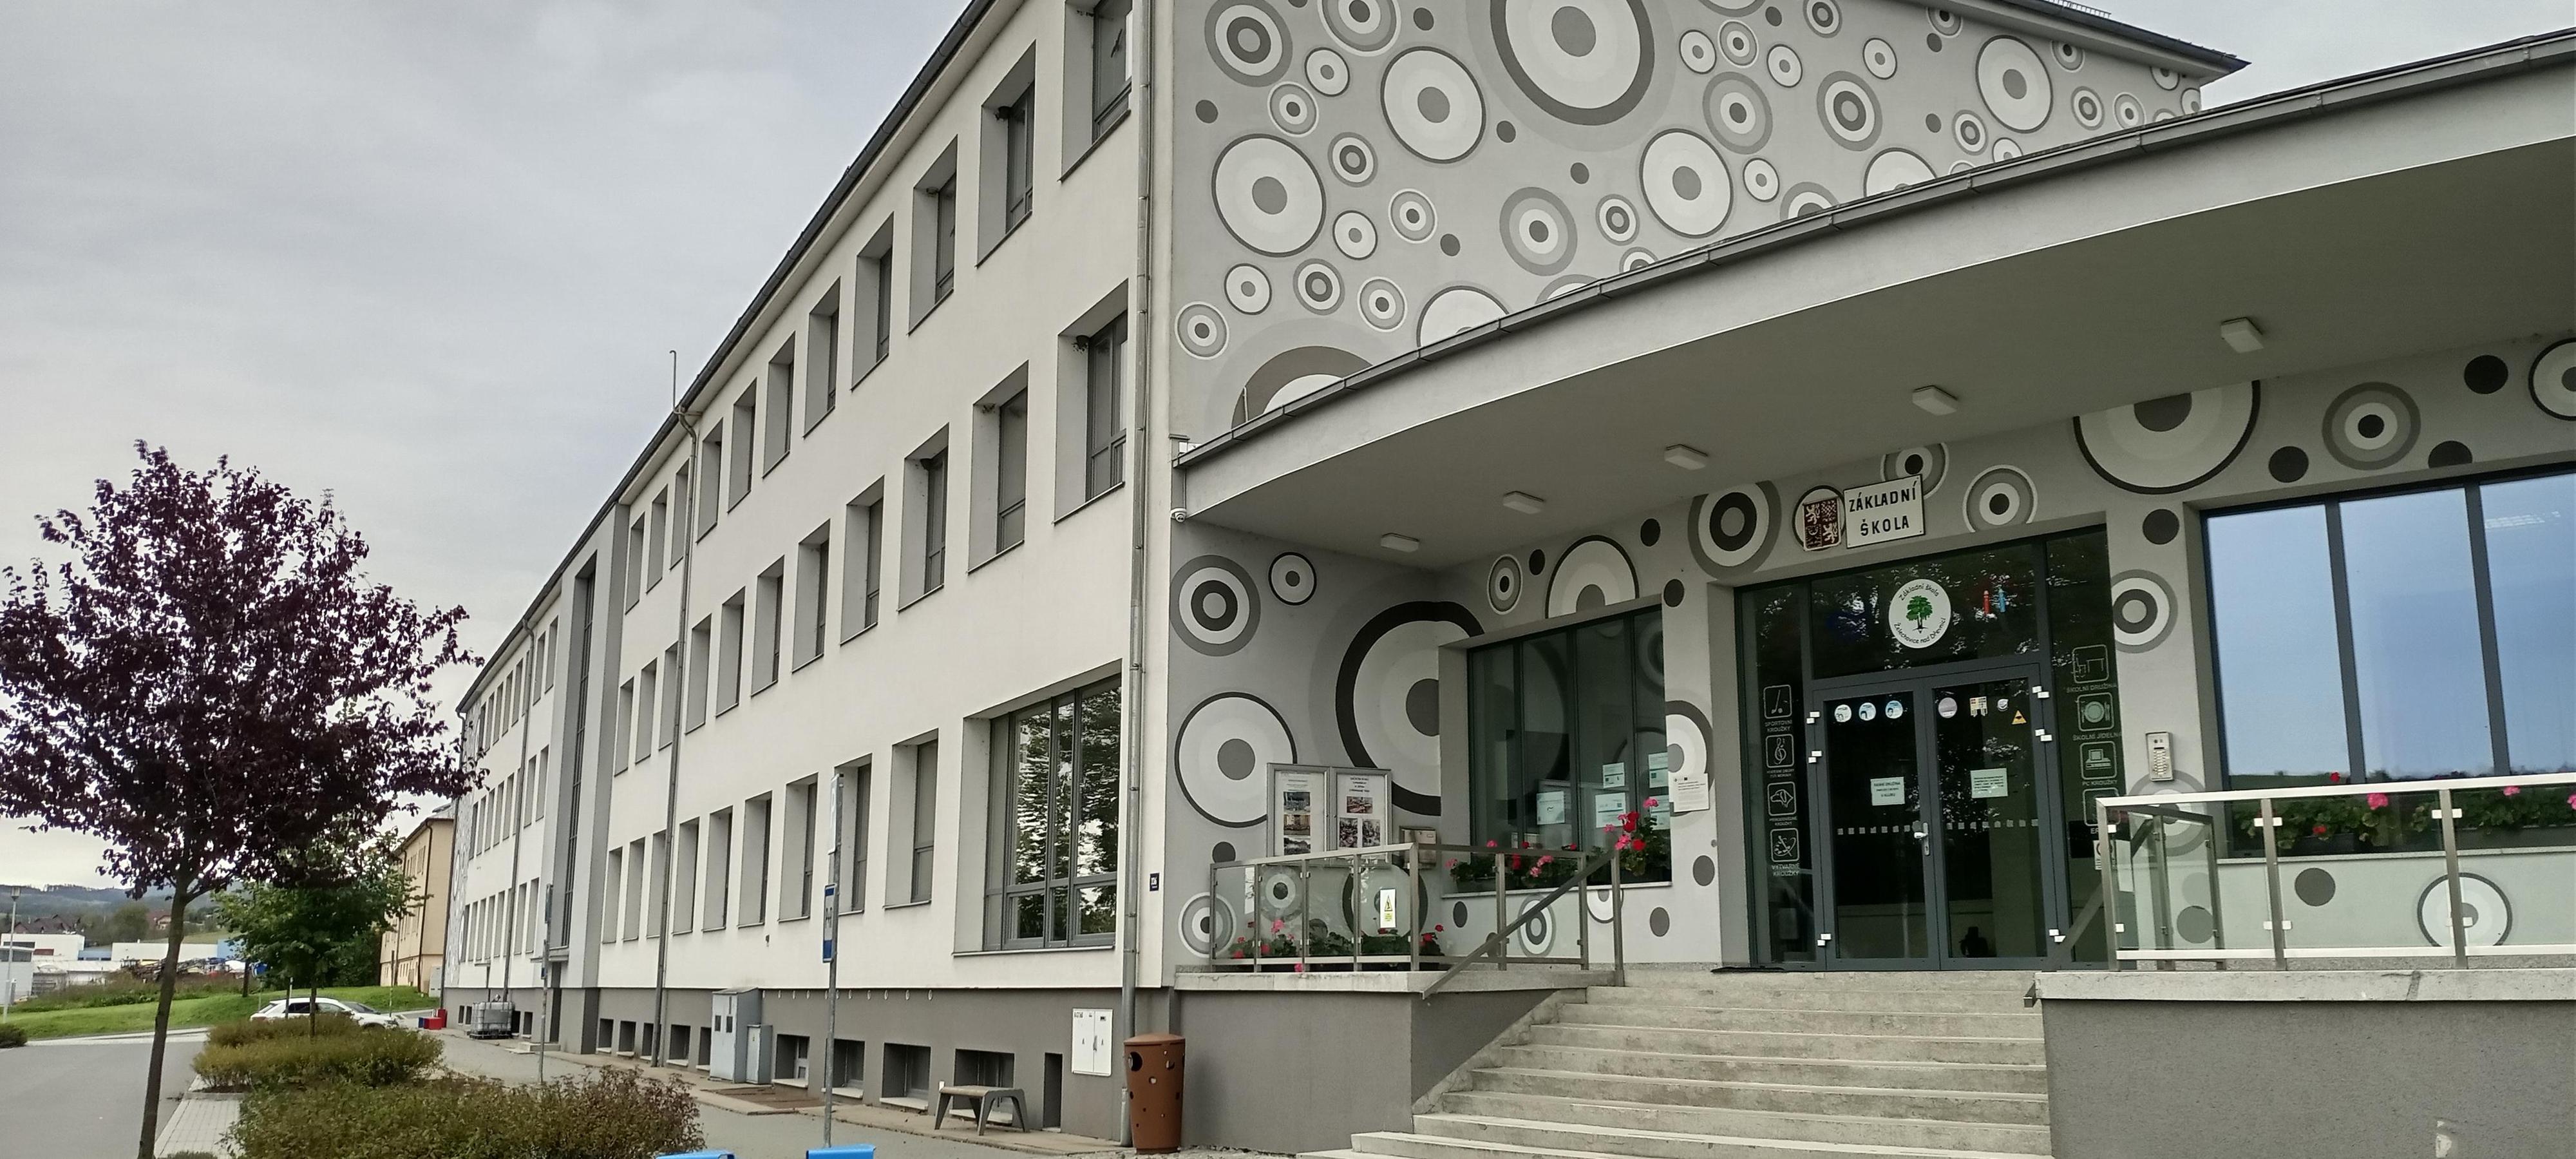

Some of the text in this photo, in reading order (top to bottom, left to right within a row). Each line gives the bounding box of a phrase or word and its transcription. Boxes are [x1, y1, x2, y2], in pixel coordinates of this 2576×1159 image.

[1848, 480, 1917, 513] ZÁKLADNÍ
[1860, 515, 1909, 537] ŠKOLA
[1899, 582, 1939, 601] Základní škola
[1894, 621, 1919, 644] Želechovice
[1920, 635, 1930, 643] nad
